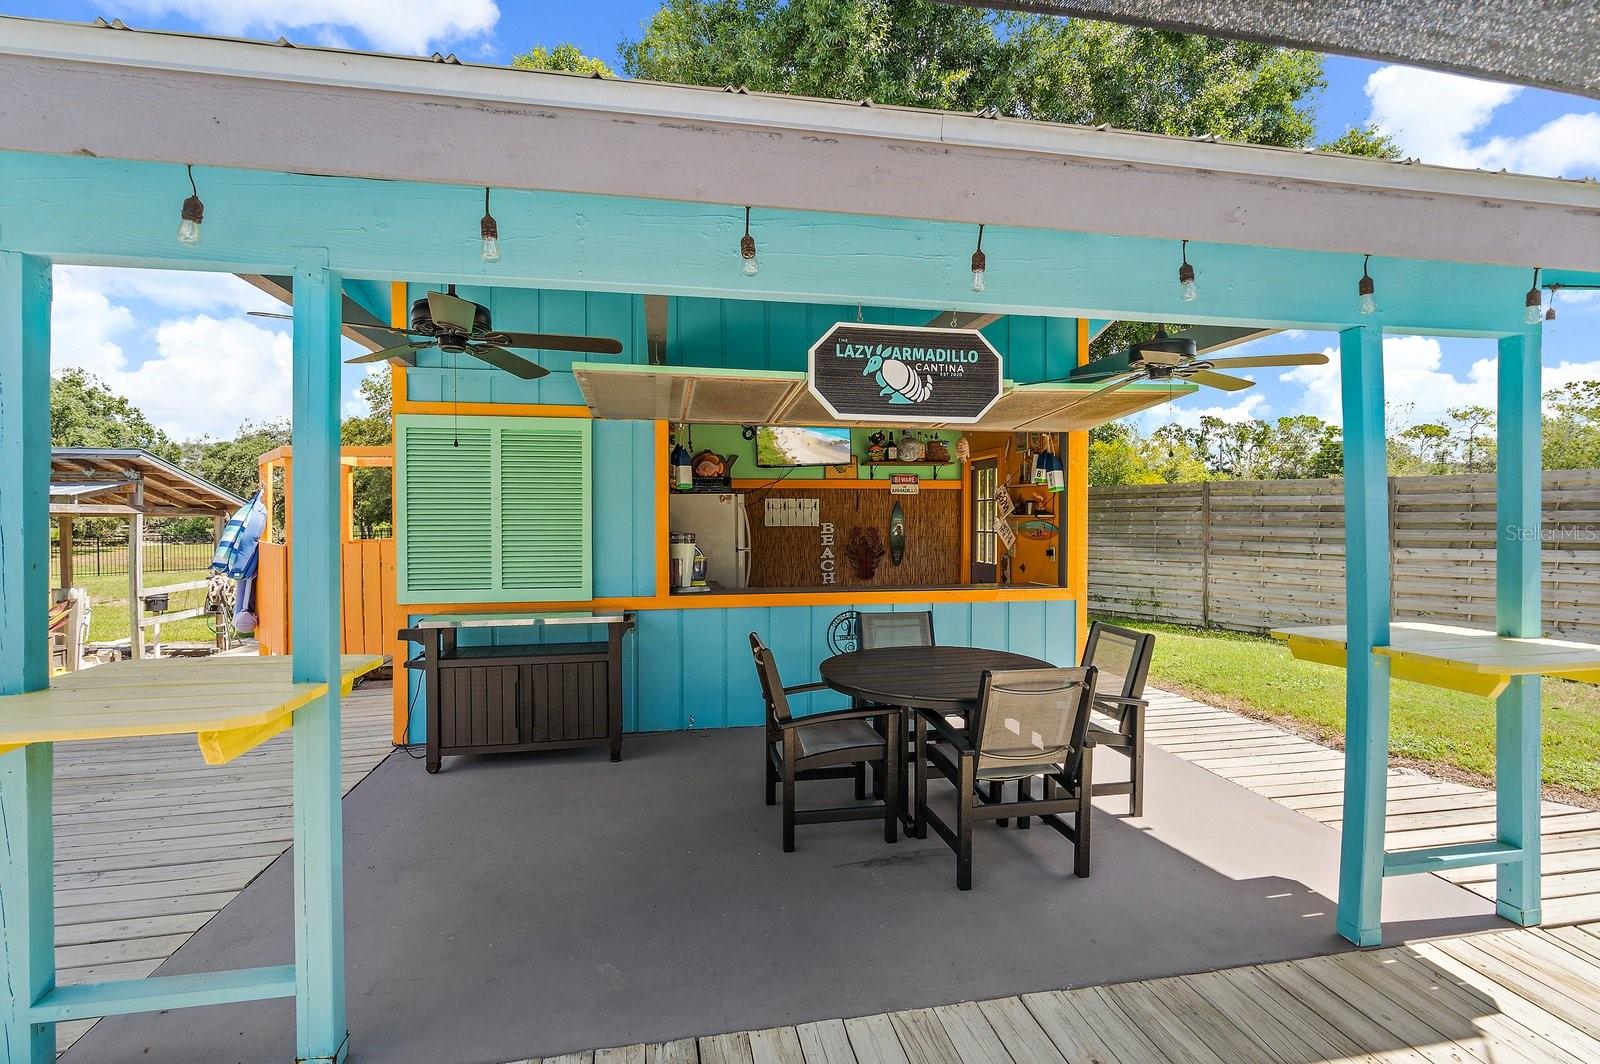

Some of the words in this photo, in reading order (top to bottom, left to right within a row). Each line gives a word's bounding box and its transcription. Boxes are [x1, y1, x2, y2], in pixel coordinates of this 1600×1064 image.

[835, 343, 874, 359] LAZY
[891, 346, 979, 364] ARMADILLO
[915, 362, 965, 374] CANTINA
[894, 476, 916, 484] BEWARE
[820, 522, 836, 585] BEACH
